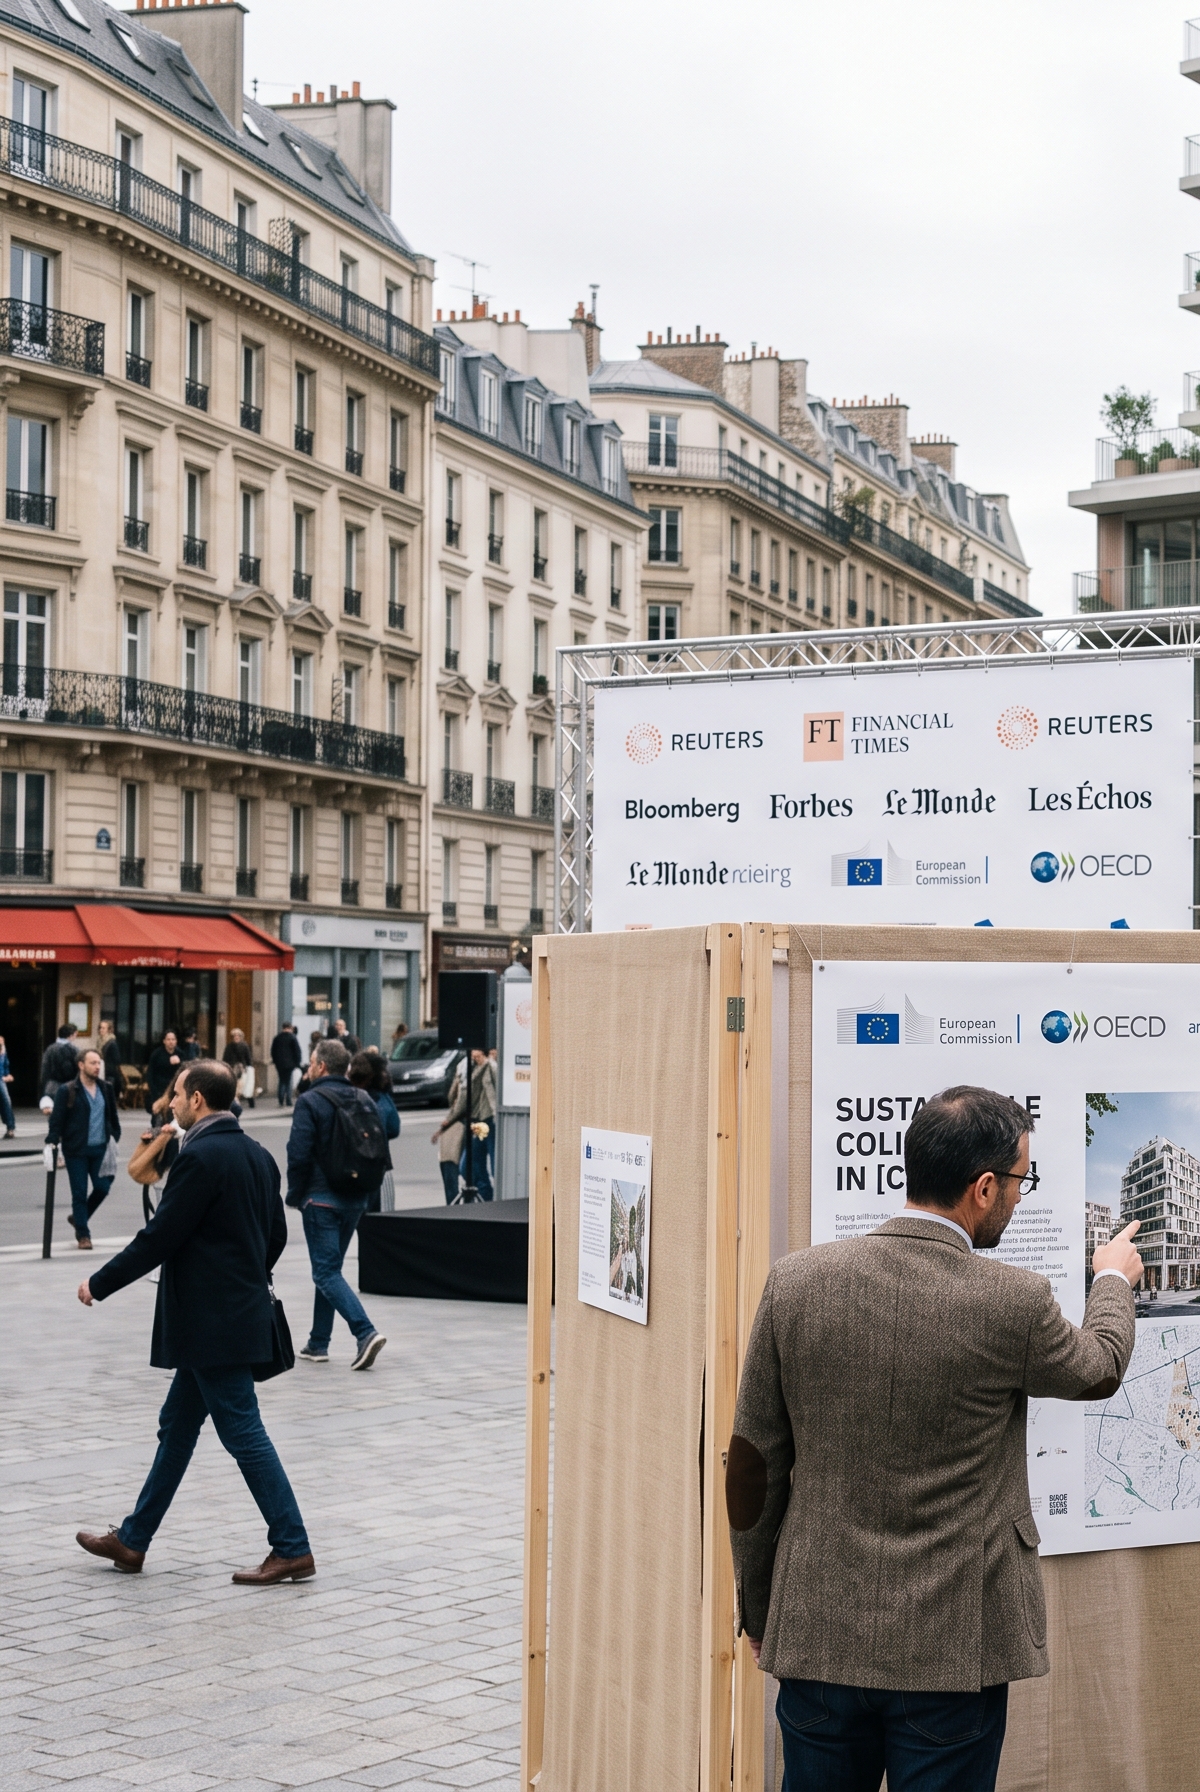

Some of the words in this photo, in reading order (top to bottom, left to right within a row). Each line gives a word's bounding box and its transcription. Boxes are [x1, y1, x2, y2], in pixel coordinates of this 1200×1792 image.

[807, 718, 841, 744] FT
[851, 713, 954, 733] FINANCIAL
[1048, 713, 1153, 736] REUTERS
[671, 730, 764, 752] REUTERS
[851, 736, 910, 754] TIMES
[769, 793, 853, 819] Forbes
[883, 789, 908, 816] Le
[911, 787, 996, 815] Monde
[1028, 787, 1072, 812] Les
[1076, 780, 1152, 811] Échos
[625, 798, 740, 823] Bloomberg
[626, 861, 649, 886] Le
[652, 860, 729, 886] Monde
[915, 860, 966, 875] European
[1080, 854, 1152, 877] OECD
[915, 872, 981, 886] Commission
[939, 1018, 996, 1031] European
[1093, 1015, 1166, 1038] OECD
[939, 1032, 1013, 1045] Commission
[836, 1165, 866, 1191] IN
